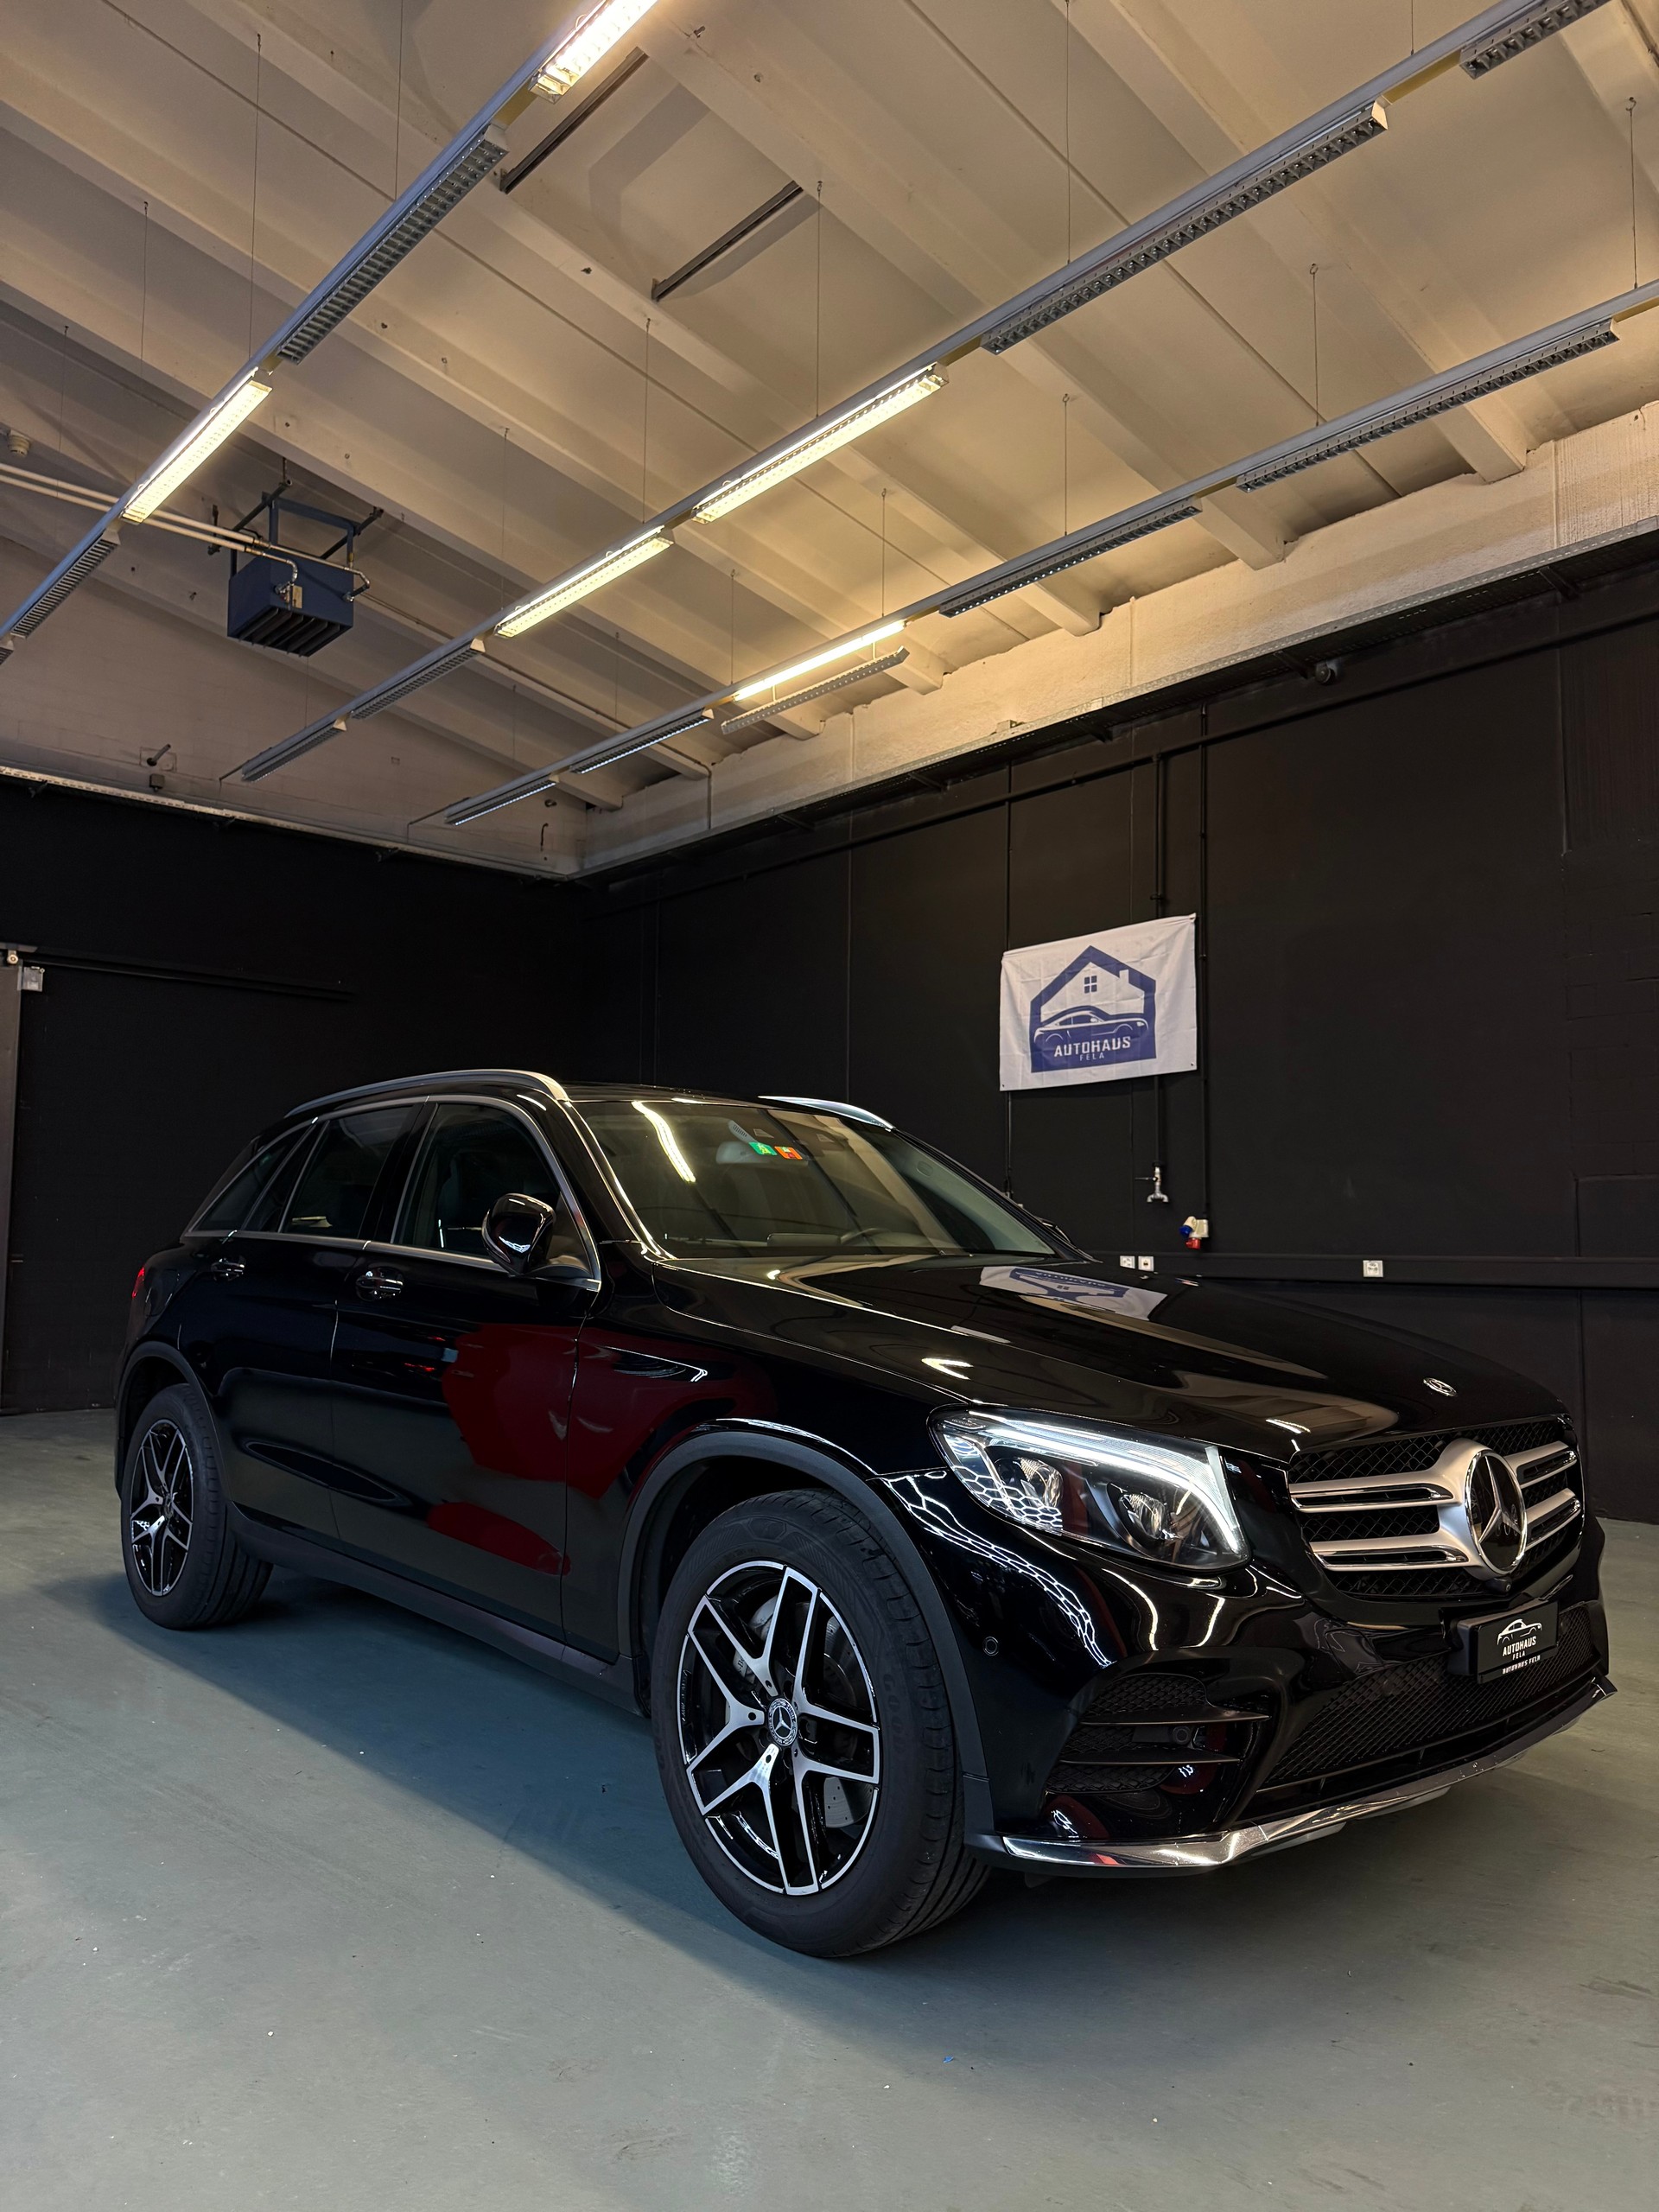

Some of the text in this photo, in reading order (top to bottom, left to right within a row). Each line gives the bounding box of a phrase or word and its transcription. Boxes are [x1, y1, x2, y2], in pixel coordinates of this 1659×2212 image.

[1054, 1036, 1131, 1058] AUTOHAUS
[1079, 1052, 1104, 1061] FELA
[1503, 1636, 1536, 1656] AUTOHAUS
[1513, 1650, 1525, 1660] FELA
[1503, 1655, 1541, 1675] AUTOHAUS FELA
